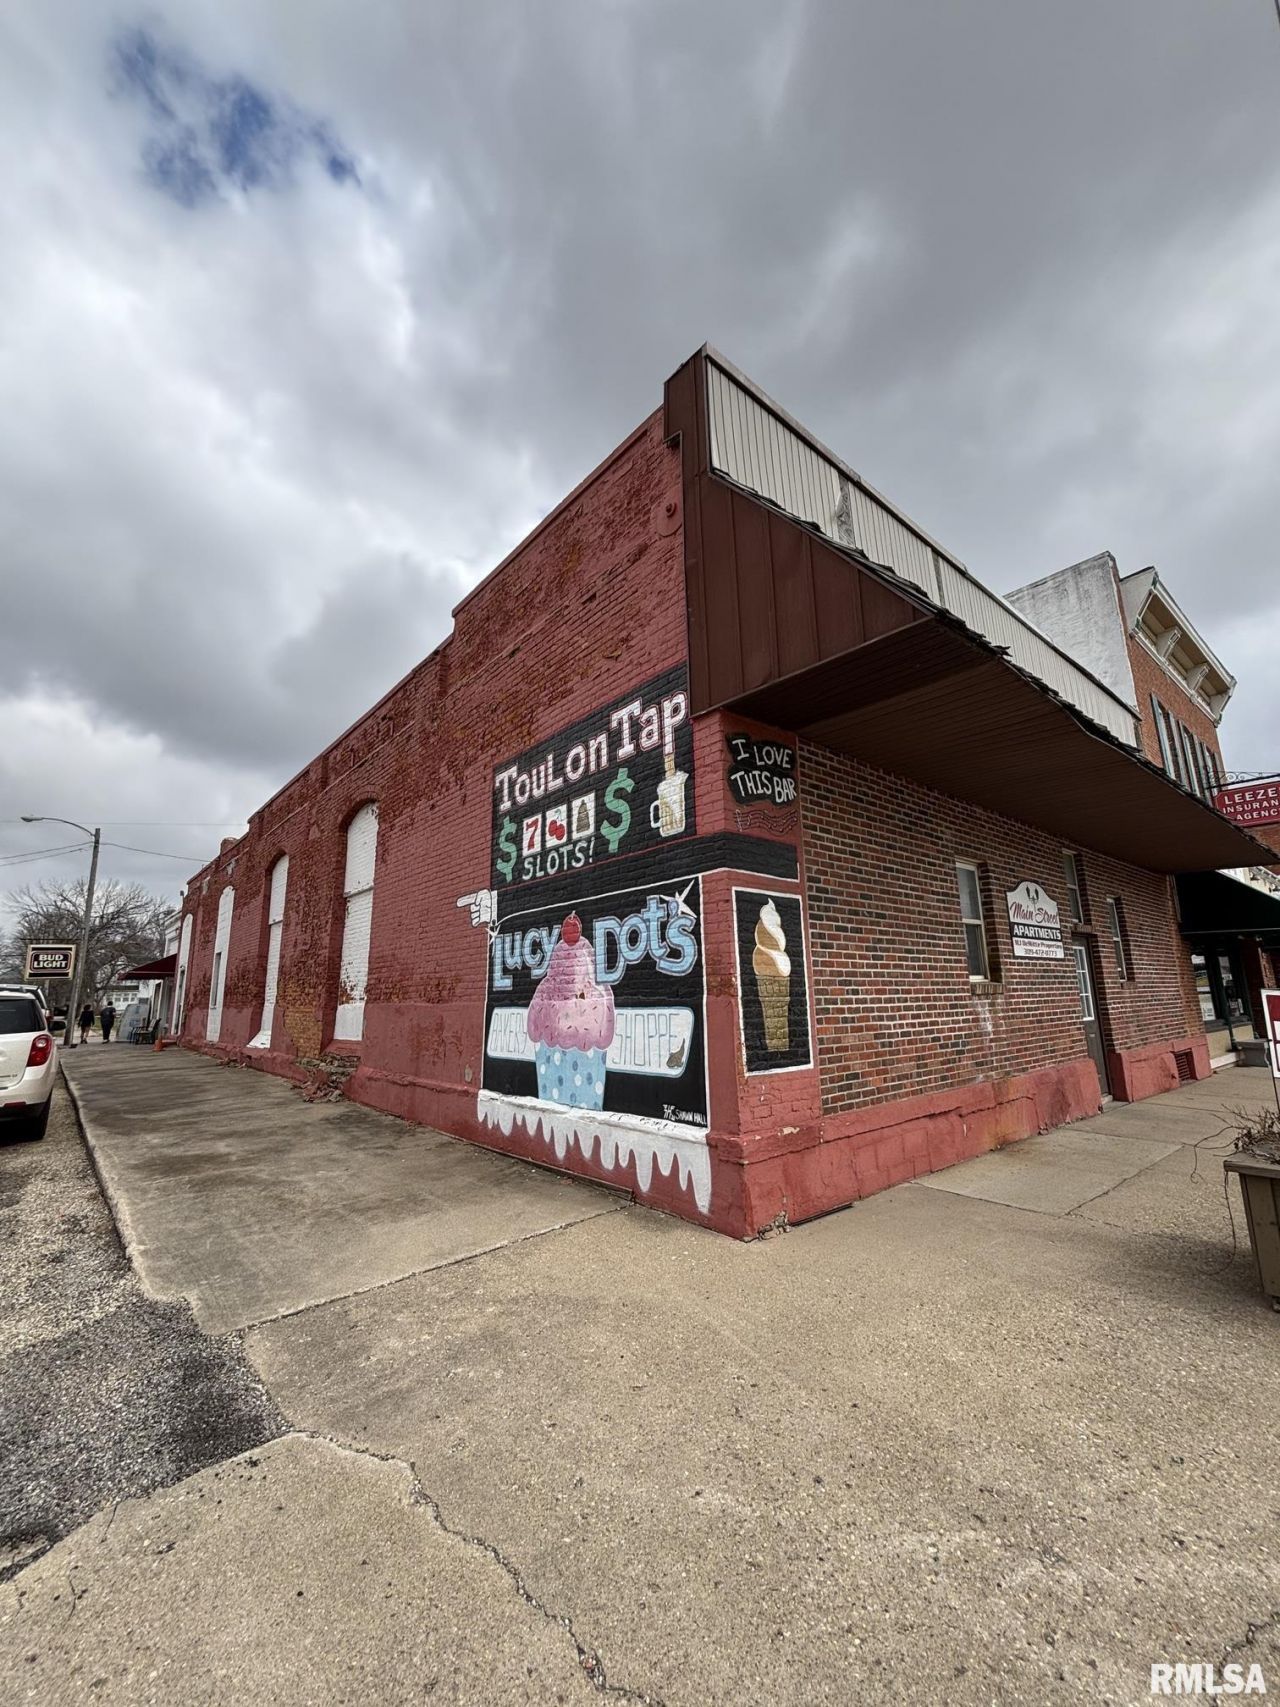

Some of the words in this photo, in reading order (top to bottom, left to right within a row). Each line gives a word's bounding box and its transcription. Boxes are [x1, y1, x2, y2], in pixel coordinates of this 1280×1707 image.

[610, 691, 688, 762] Tap
[732, 739, 750, 760] I
[753, 745, 792, 768] LOVE
[730, 770, 772, 797] THIS
[773, 776, 797, 803] BAR
[1224, 787, 1280, 805] LEEZE
[1236, 808, 1280, 820] AGENC
[522, 837, 596, 880] SLOTS!
[1010, 901, 1033, 921] Main
[1034, 907, 1059, 925] Street
[493, 925, 561, 990] Lucy
[593, 895, 698, 986] Dot's
[1013, 924, 1061, 940] APARTMENTS
[33, 960, 67, 968] LIGHT
[612, 1013, 680, 1068] SHOPPE
